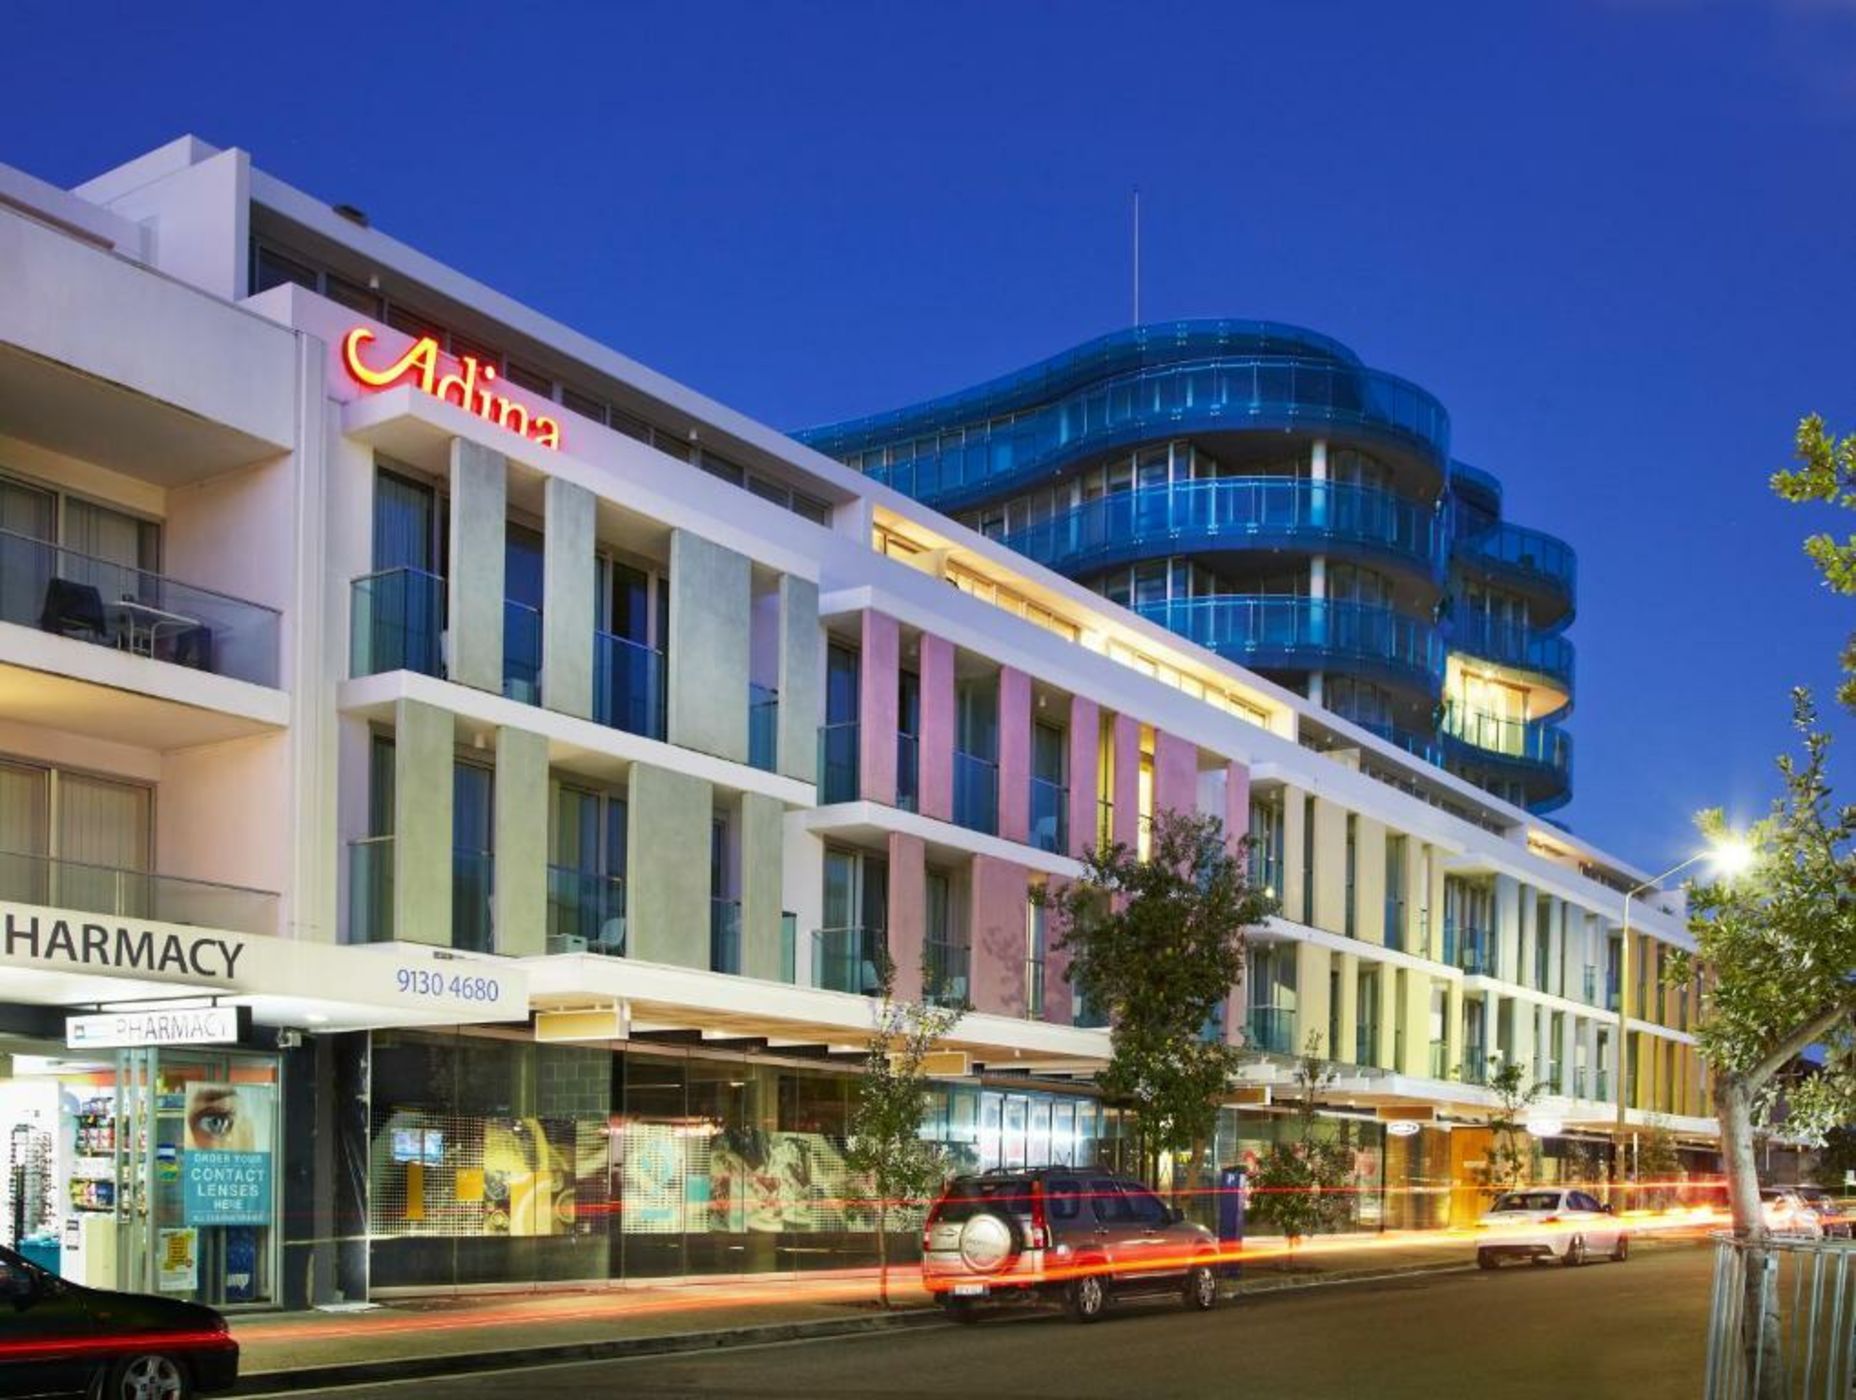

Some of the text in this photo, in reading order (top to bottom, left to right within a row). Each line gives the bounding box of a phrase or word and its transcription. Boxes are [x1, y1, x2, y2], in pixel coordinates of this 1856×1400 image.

[345, 328, 560, 450] Adina
[5, 914, 244, 979] HARMACY
[397, 969, 499, 1001] 9130 4680
[191, 1167, 265, 1182] CONTACT
[197, 1183, 259, 1197] LENSES
